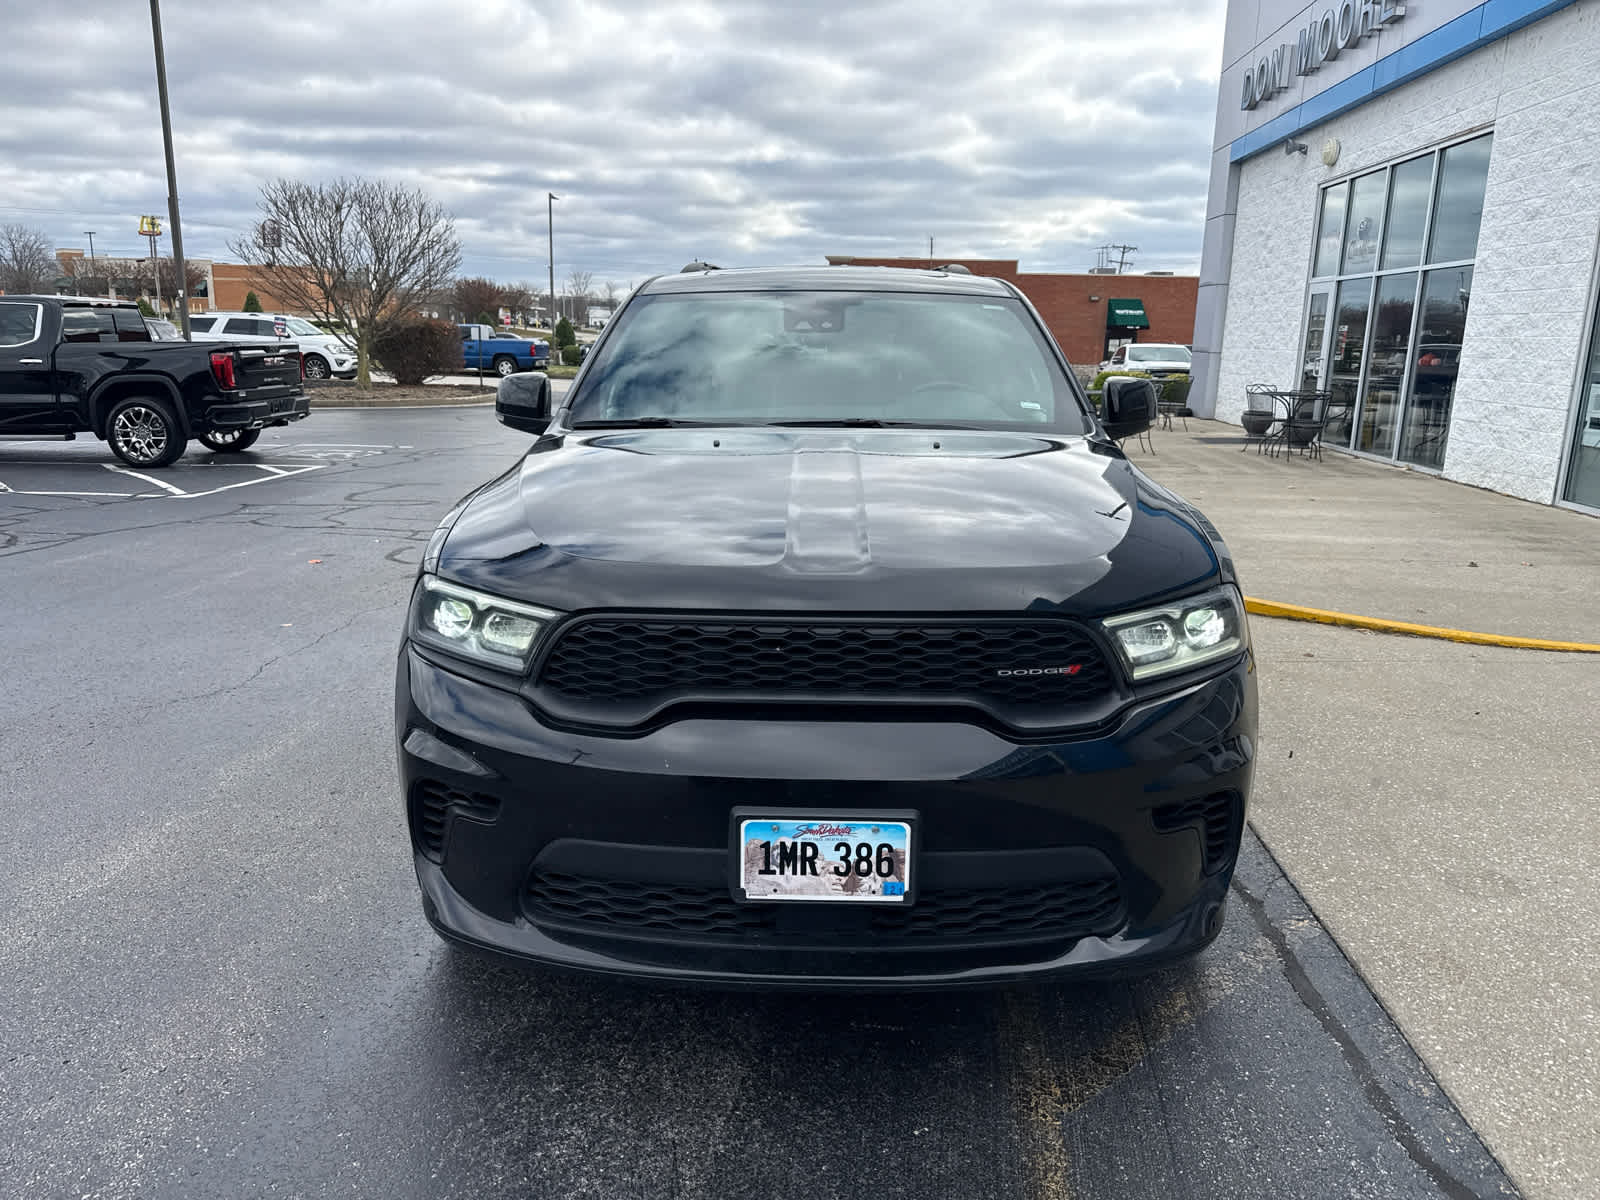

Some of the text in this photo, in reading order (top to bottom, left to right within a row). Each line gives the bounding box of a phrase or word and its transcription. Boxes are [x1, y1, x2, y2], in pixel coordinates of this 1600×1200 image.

[1241, 43, 1291, 110] DON
[998, 667, 1072, 676] DODGE
[758, 840, 894, 877] 1MR 386
